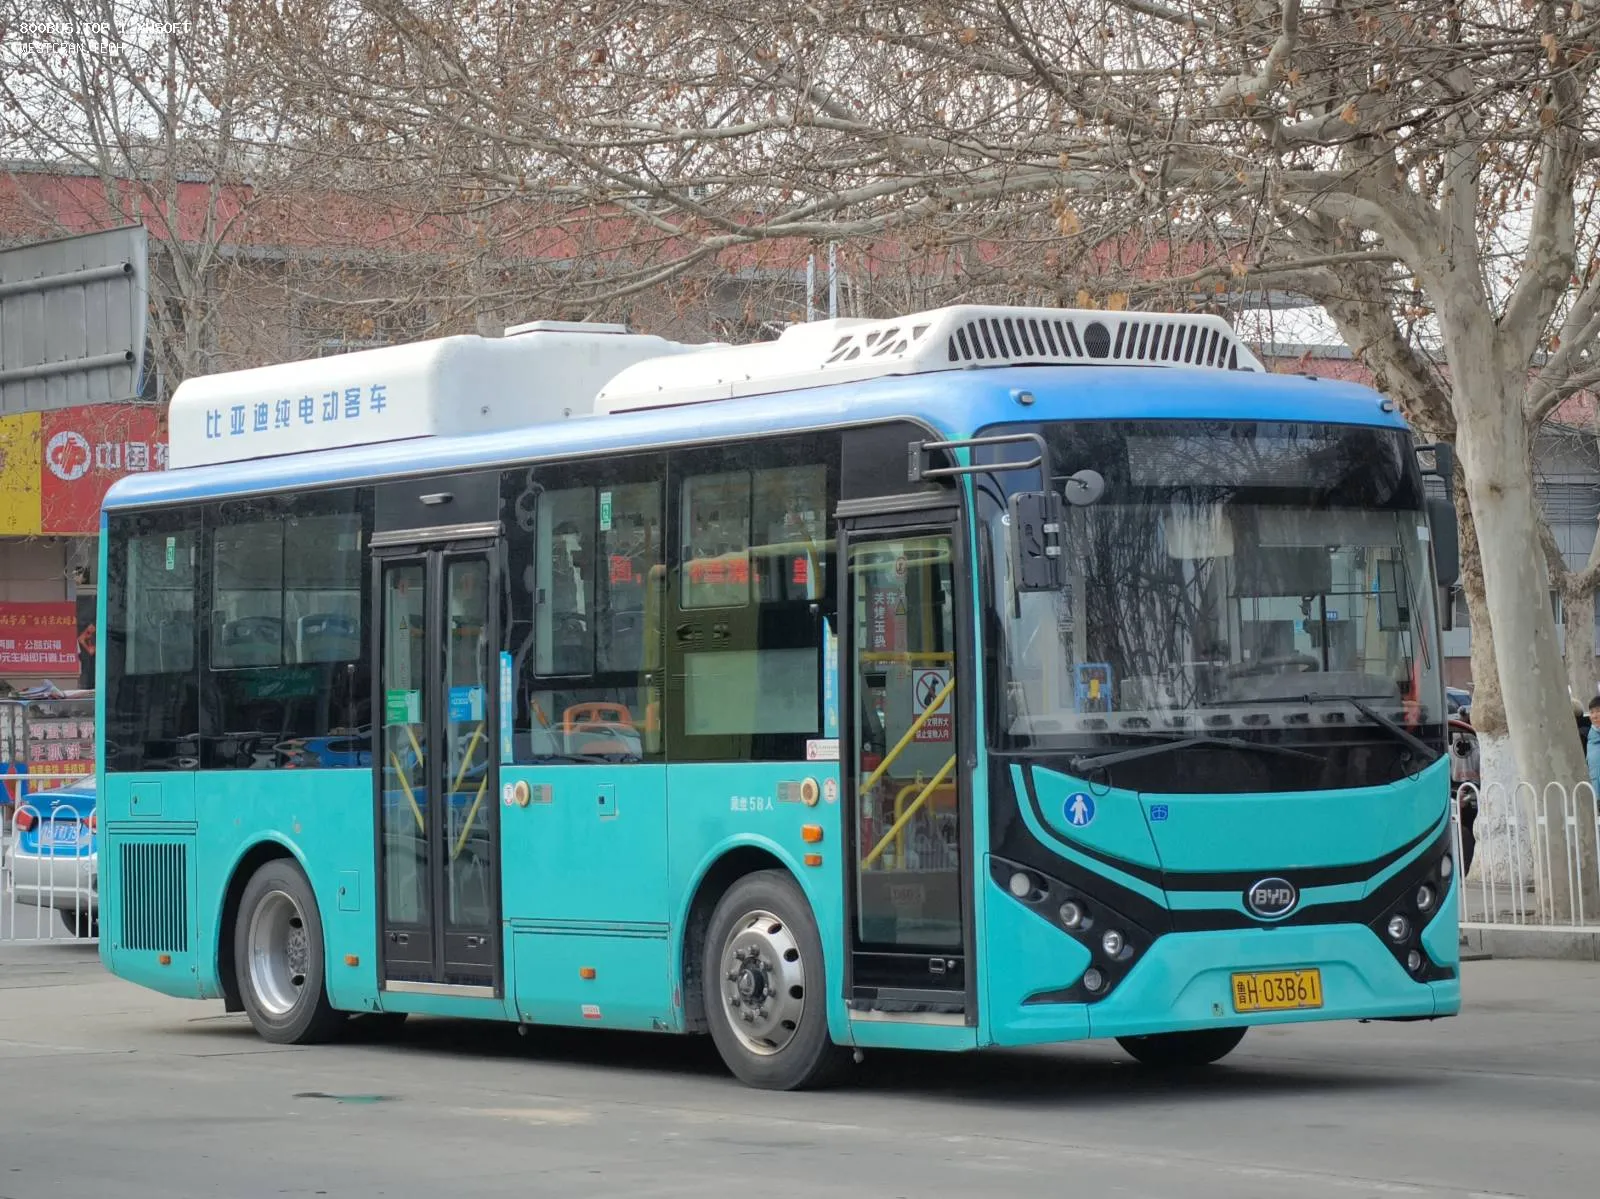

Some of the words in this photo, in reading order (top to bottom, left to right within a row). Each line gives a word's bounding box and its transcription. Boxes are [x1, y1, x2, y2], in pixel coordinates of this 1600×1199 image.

[205, 384, 387, 439] 比亚迪纯电动客车
[1255, 888, 1291, 905] BYD
